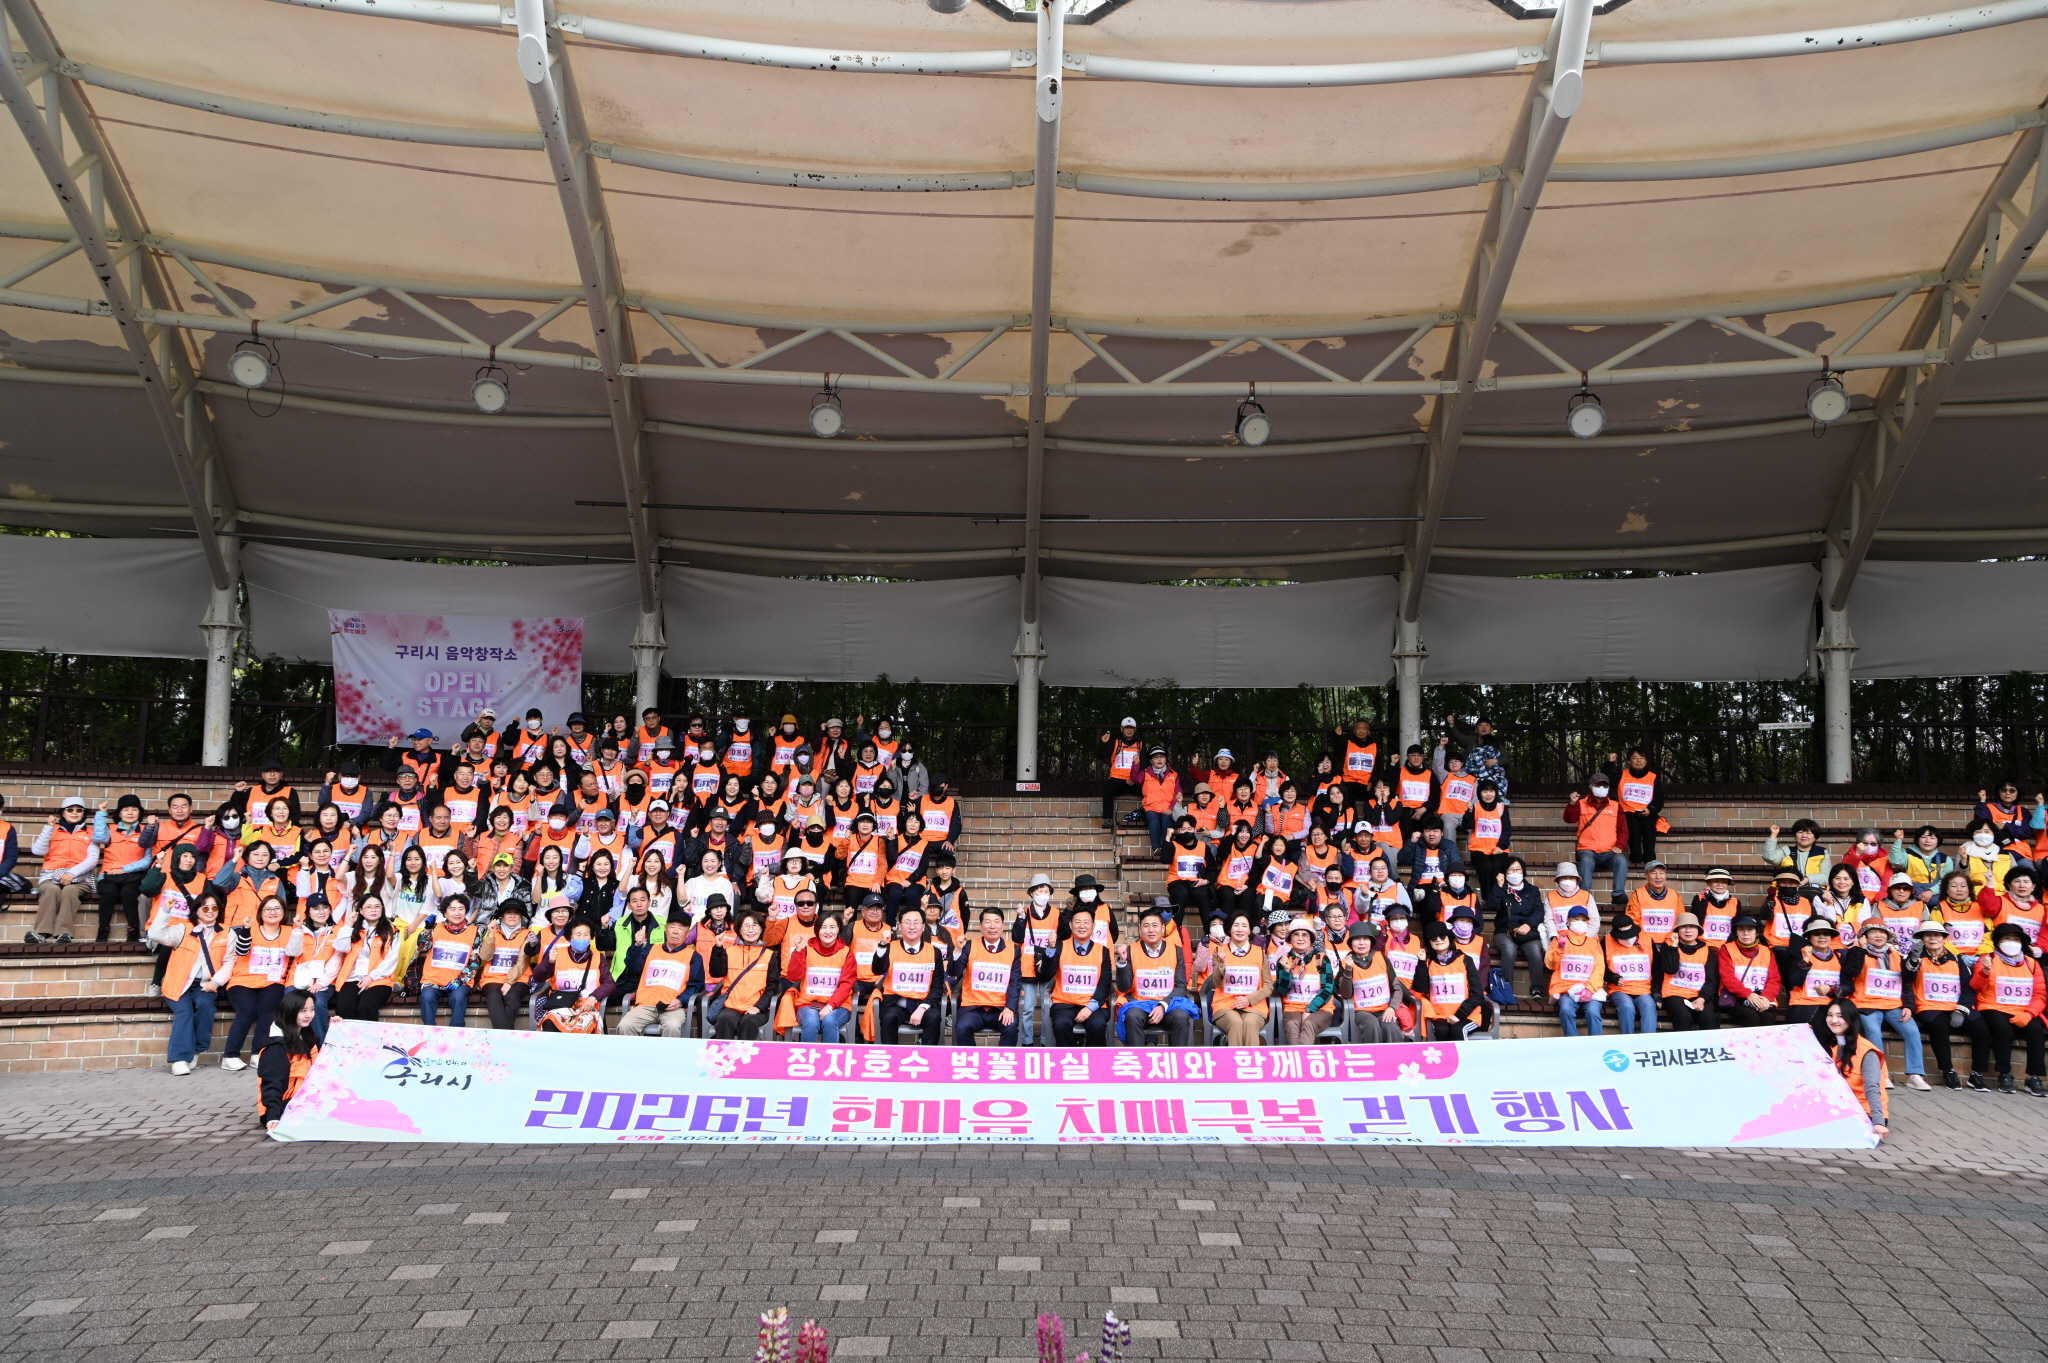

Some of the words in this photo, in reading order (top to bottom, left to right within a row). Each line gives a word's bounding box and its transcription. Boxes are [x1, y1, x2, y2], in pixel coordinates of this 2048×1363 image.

[395, 645, 439, 661] 구리시
[445, 646, 518, 662] 음악창작소
[424, 671, 492, 694] OPEN
[416, 697, 499, 718] STAGE
[1407, 787, 1424, 796] 118
[1452, 788, 1466, 796] 116
[1628, 789, 1646, 798] 158
[622, 818, 639, 826] 12
[670, 813, 684, 824] 076
[900, 857, 916, 866] 079
[174, 900, 188, 910] 53
[1649, 916, 1668, 926] 059
[1710, 922, 1730, 932] 063
[1783, 922, 1804, 931] 06
[1889, 926, 1914, 934] 046
[1953, 930, 1978, 939] 069
[2025, 928, 2039, 938] 39
[258, 957, 281, 966] 124
[442, 954, 457, 962] 218
[1394, 960, 1412, 971] 071
[1567, 964, 1588, 973] 062
[1620, 964, 1644, 972] 068
[652, 968, 676, 980] 078
[900, 972, 924, 982] 0411
[978, 971, 1003, 982] 0411
[1068, 974, 1092, 984] 0411
[1678, 970, 1700, 982] 045
[812, 976, 838, 986] 0411
[1142, 978, 1168, 988] 0411
[1230, 975, 1252, 985] 0411
[1744, 975, 1766, 985] 065
[1874, 978, 1897, 990] 047
[1292, 984, 1312, 994] 114
[1361, 986, 1383, 998] 120
[1436, 984, 1456, 994] 141
[1932, 982, 1958, 994] 054
[2004, 986, 2031, 997] 053
[1634, 1046, 1736, 1068] 구리시보건소
[787, 1048, 930, 1080] 장자호수
[950, 1052, 1092, 1080] 벚꽃마실
[1111, 1051, 1216, 1080] 축제와
[1232, 1048, 1376, 1079] 함께하는
[384, 1066, 472, 1090] 구리시
[524, 1088, 809, 1133] 2026년
[831, 1096, 1033, 1134] 한마음
[1054, 1096, 1325, 1134] 치매극복
[1342, 1093, 1479, 1134] 걷기
[1491, 1088, 1634, 1132] 행사
